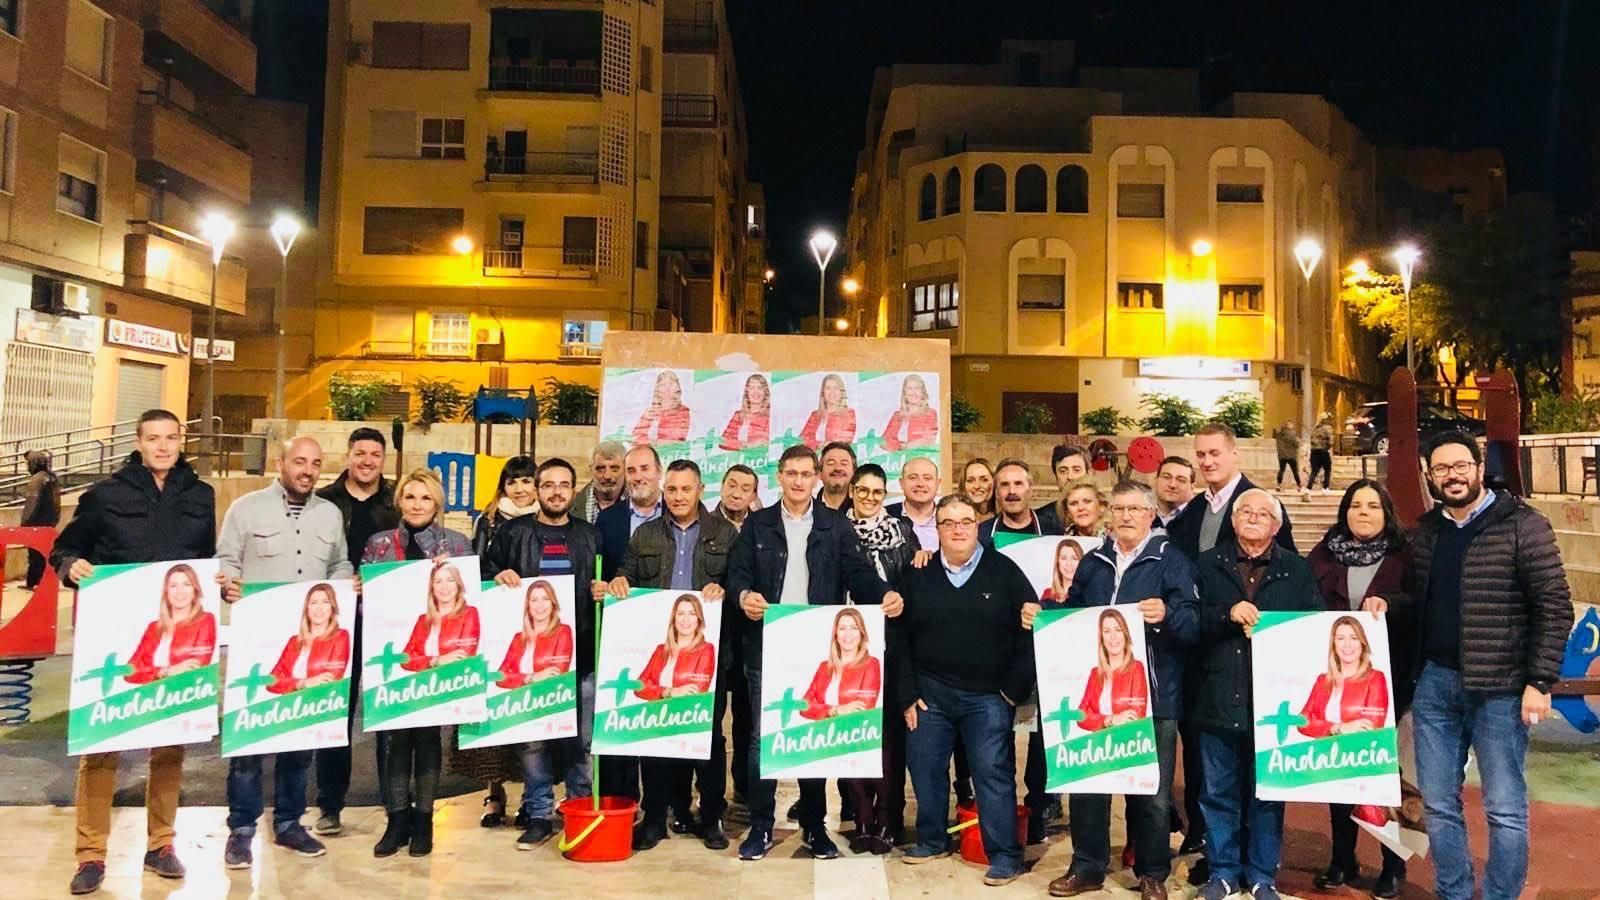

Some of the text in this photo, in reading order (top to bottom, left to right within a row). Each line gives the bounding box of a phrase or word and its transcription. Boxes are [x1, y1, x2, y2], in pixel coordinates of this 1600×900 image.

[124, 327, 172, 350] FRUTERIA
[196, 343, 232, 356] FRTERIA
[89, 679, 218, 727] Andalucía
[374, 667, 486, 708] Andalucía
[487, 684, 576, 720] ndalucía
[234, 689, 349, 732] Andalucía
[604, 703, 713, 732] Andalucía
[772, 720, 881, 756] Andalucía
[1055, 731, 1157, 769] Andalucía
[1268, 741, 1397, 775] Andalucía
